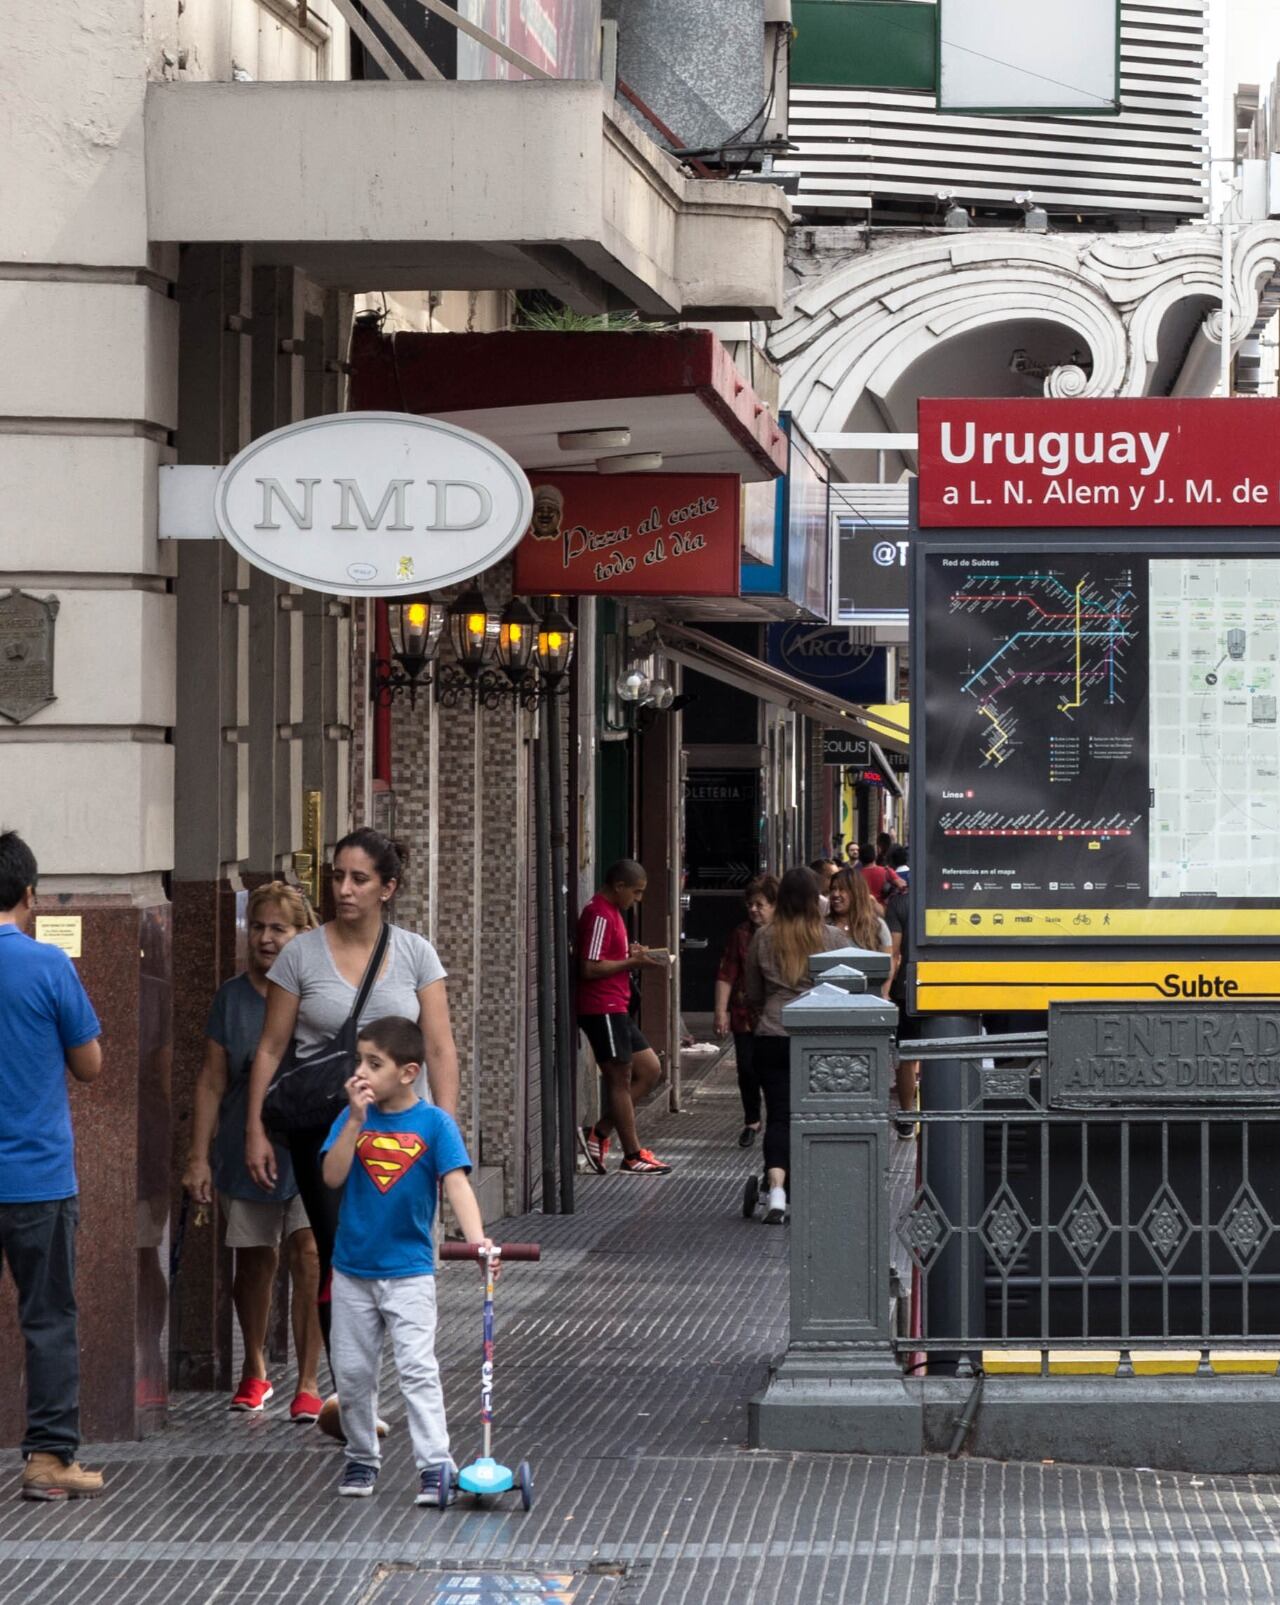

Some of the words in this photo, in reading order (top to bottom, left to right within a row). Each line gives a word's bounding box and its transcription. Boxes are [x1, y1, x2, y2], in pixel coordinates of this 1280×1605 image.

[940, 421, 1170, 476] Uruguay
[253, 477, 494, 532] NMD
[942, 486, 959, 504] a
[970, 480, 992, 504] L.
[1003, 480, 1033, 504] N.
[1043, 479, 1119, 504] Alem
[1129, 485, 1145, 510] y
[1154, 479, 1175, 504] J.
[1186, 480, 1222, 503] M.
[1233, 478, 1269, 503] de
[562, 525, 632, 568] Pizza
[638, 506, 663, 535] al
[667, 497, 719, 526] corte
[594, 551, 636, 582] todo
[643, 537, 668, 566] el
[1163, 974, 1239, 998] Subte
[1069, 1058, 1168, 1087] AMBAS
